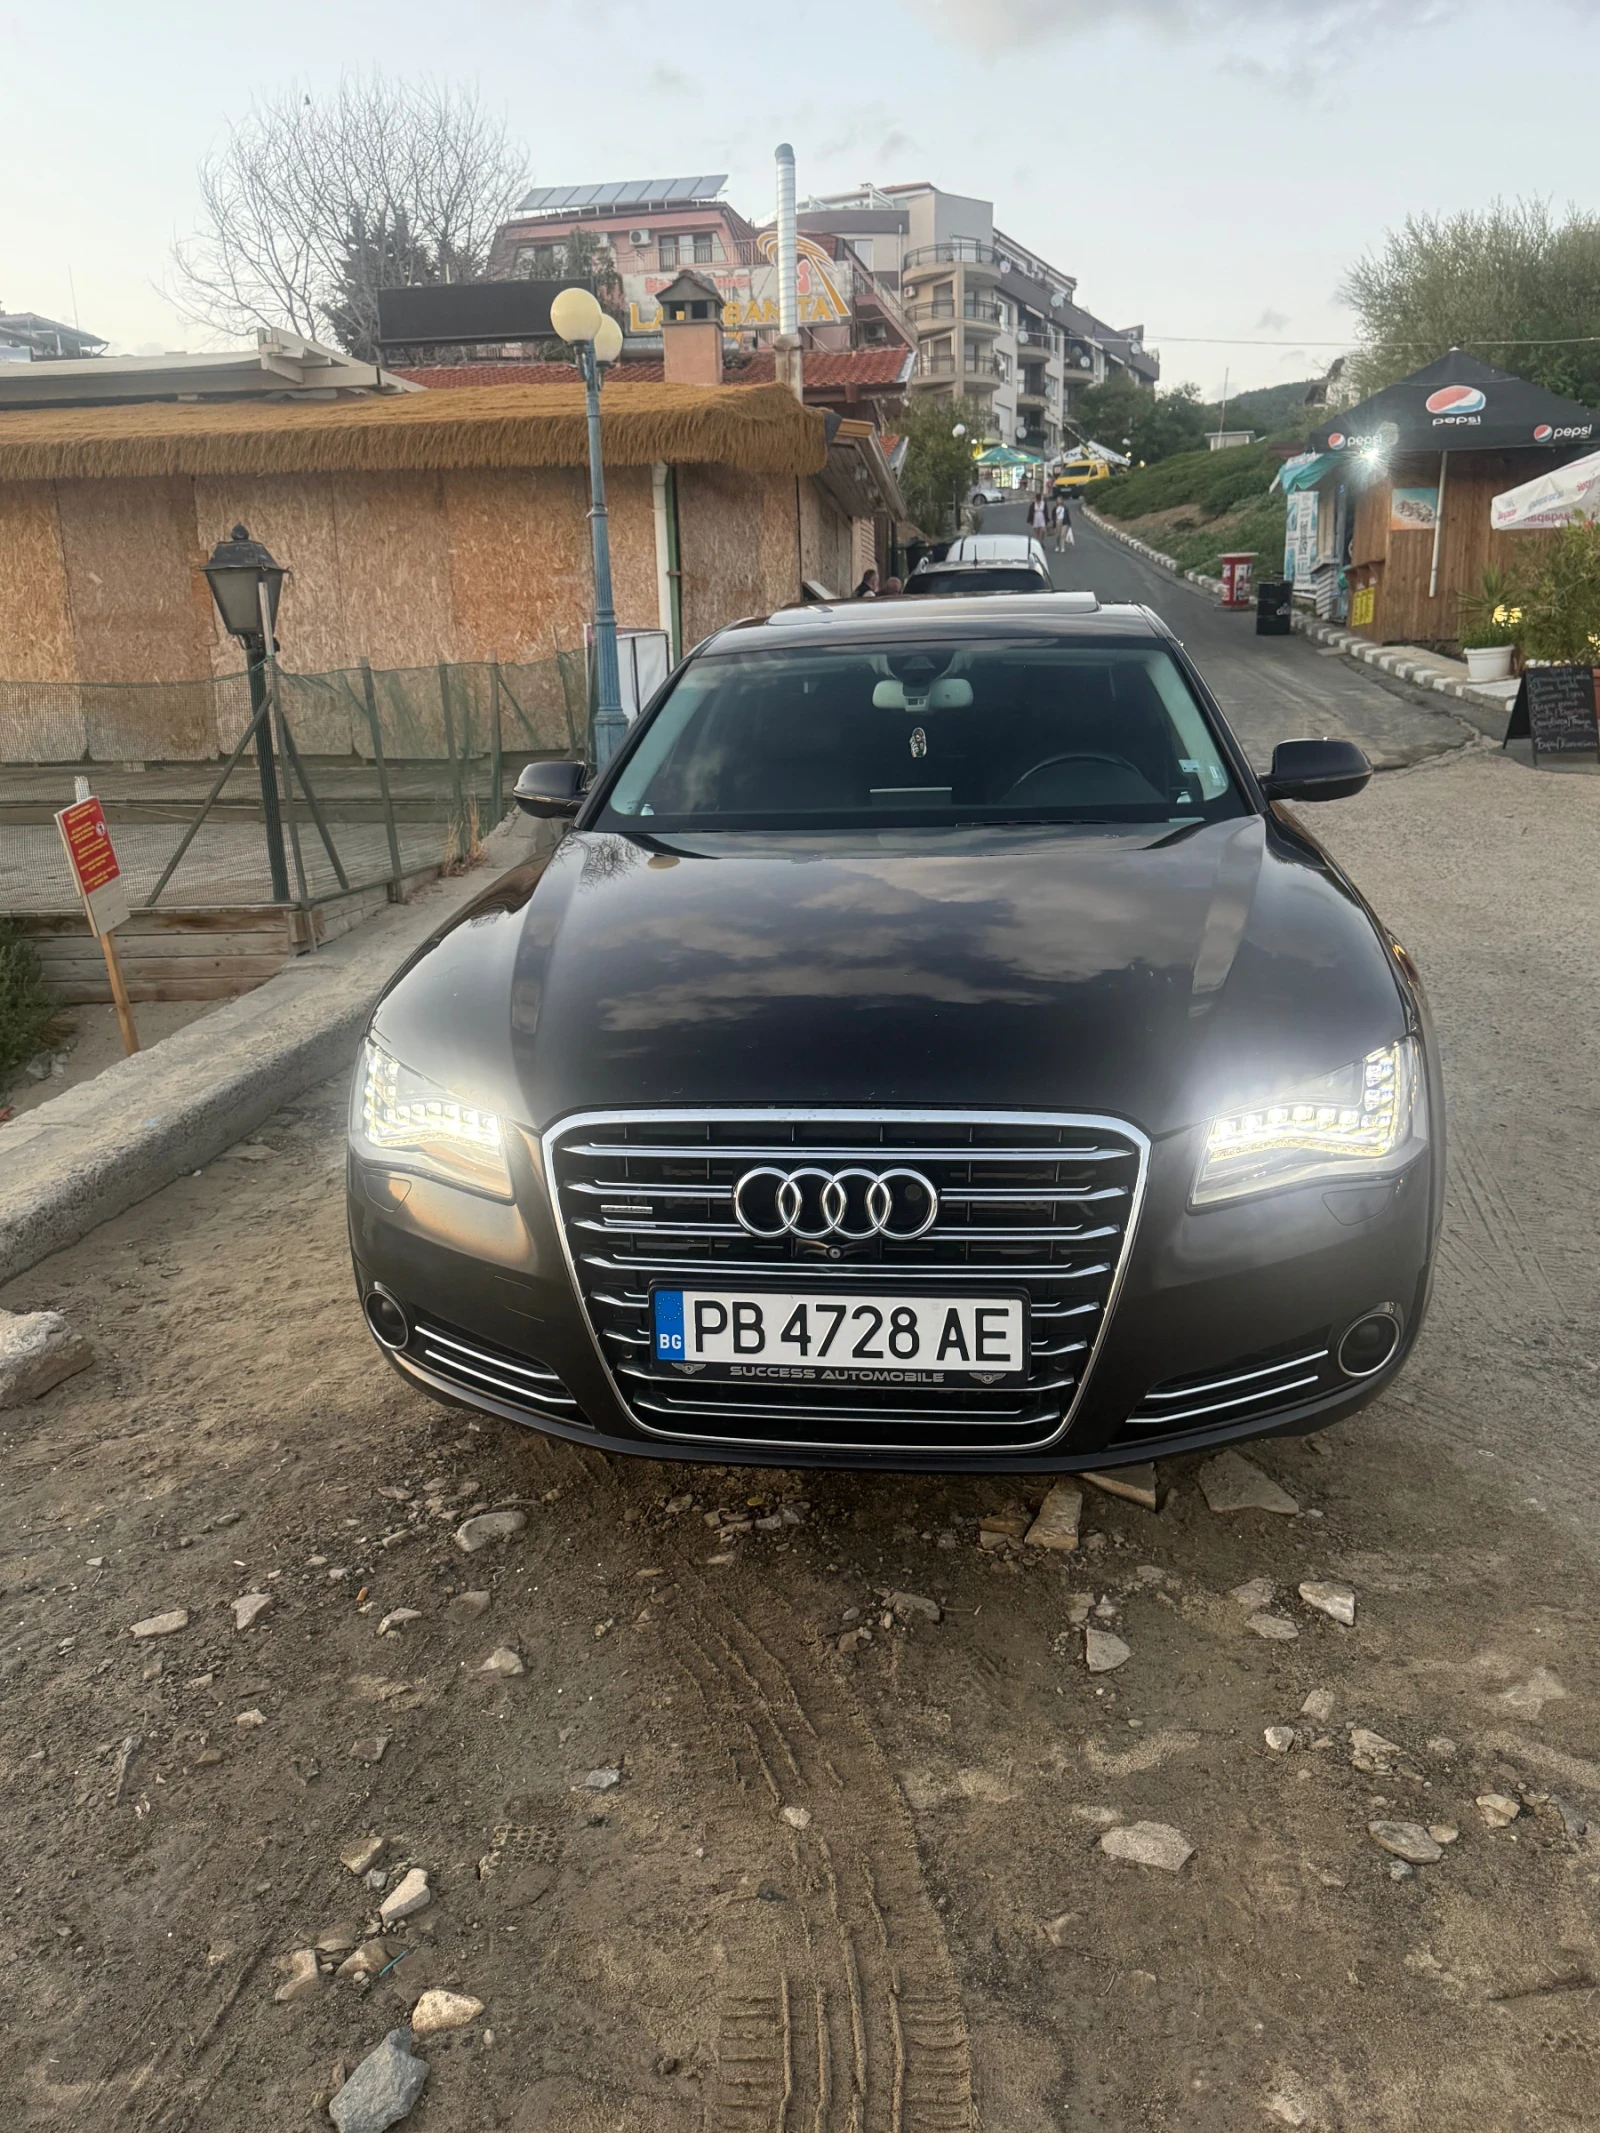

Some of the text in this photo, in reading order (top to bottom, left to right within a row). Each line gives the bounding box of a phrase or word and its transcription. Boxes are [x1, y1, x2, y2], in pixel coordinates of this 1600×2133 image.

[1432, 415, 1481, 426] pepsi
[1552, 424, 1593, 439] pepsi
[1347, 433, 1382, 447] pepsi
[693, 1299, 1012, 1362] PB 4728 AE
[659, 1333, 682, 1350] BG
[729, 1366, 945, 1383] SUCCESS AUTOMOBILE
